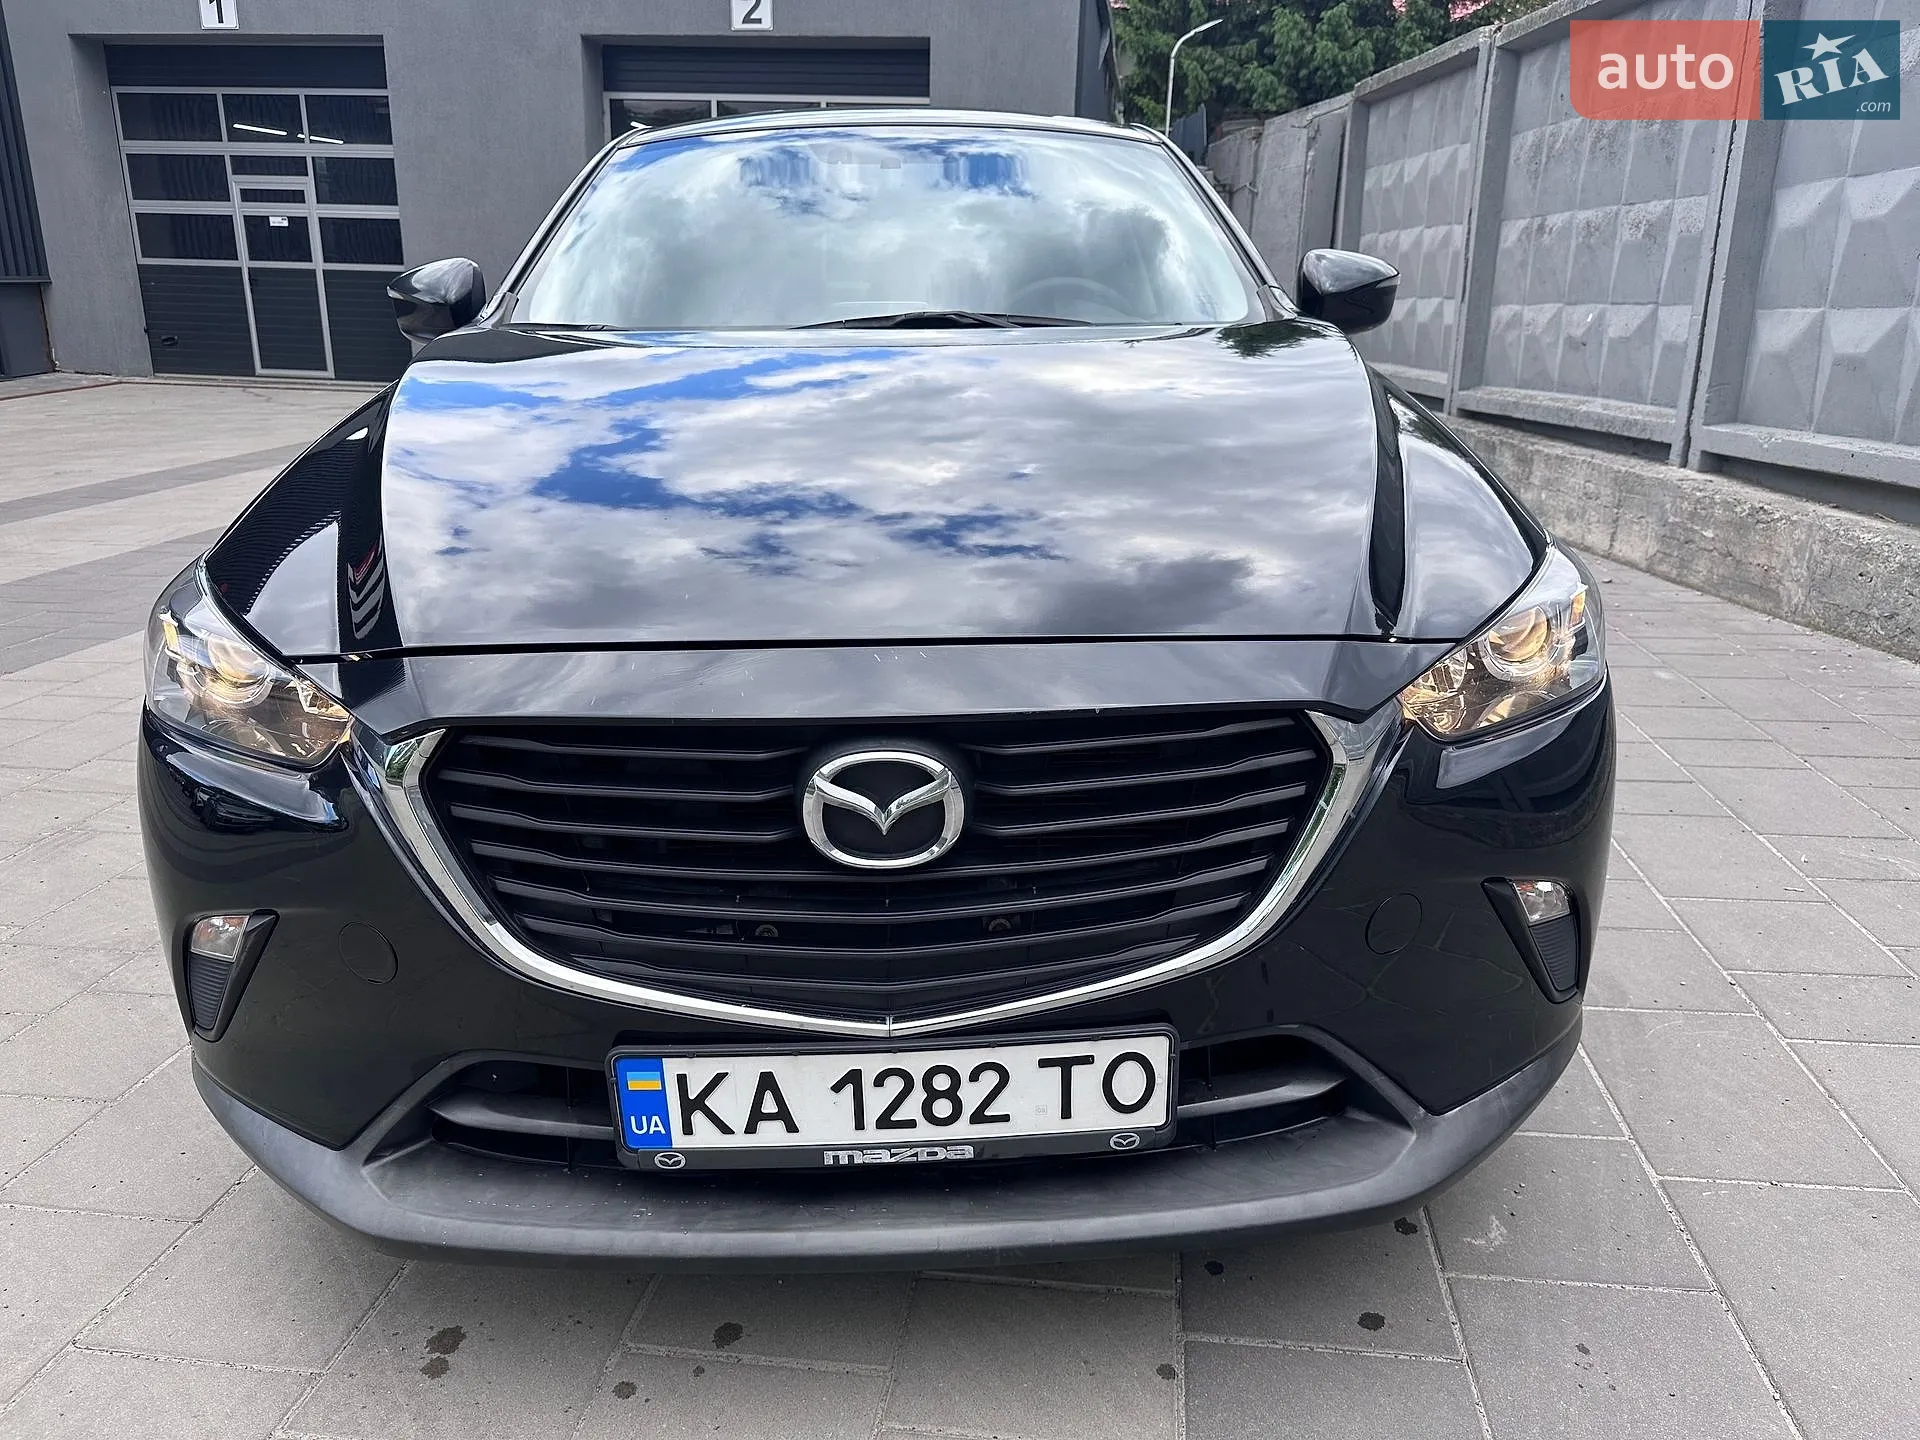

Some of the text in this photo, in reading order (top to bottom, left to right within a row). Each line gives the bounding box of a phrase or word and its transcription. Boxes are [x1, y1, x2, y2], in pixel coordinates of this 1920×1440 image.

[209, 0, 224, 24] 1
[741, 0, 762, 24] 2
[676, 1051, 1156, 1136] KA 1282 TO
[630, 1115, 666, 1135] UA
